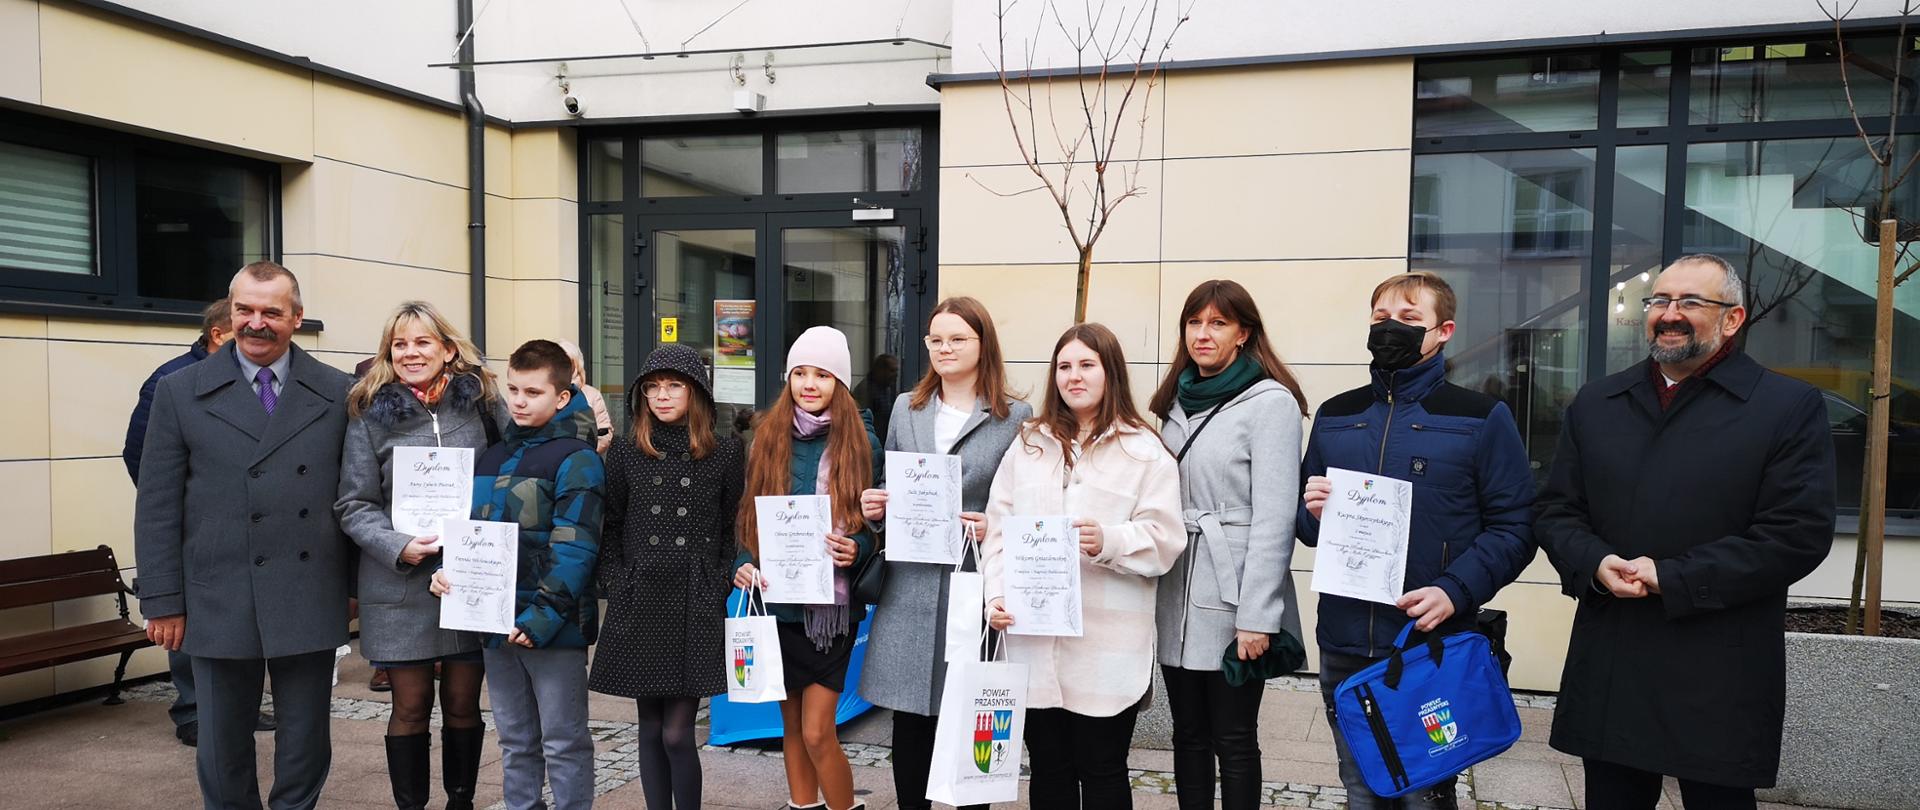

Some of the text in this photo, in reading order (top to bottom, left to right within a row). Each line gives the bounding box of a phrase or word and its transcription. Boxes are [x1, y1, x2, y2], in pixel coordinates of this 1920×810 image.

[414, 461, 451, 475] Dyplom
[904, 468, 939, 483] Dyplom
[1347, 489, 1387, 506] Dyplom
[775, 510, 810, 525] Dyplom
[461, 535, 495, 550] Dyplom
[1021, 533, 1058, 548] Dyplom
[982, 688, 1011, 698] POWIAT
[974, 698, 1017, 707] PRZASNYSKI
[1420, 697, 1442, 711] POWIAT
